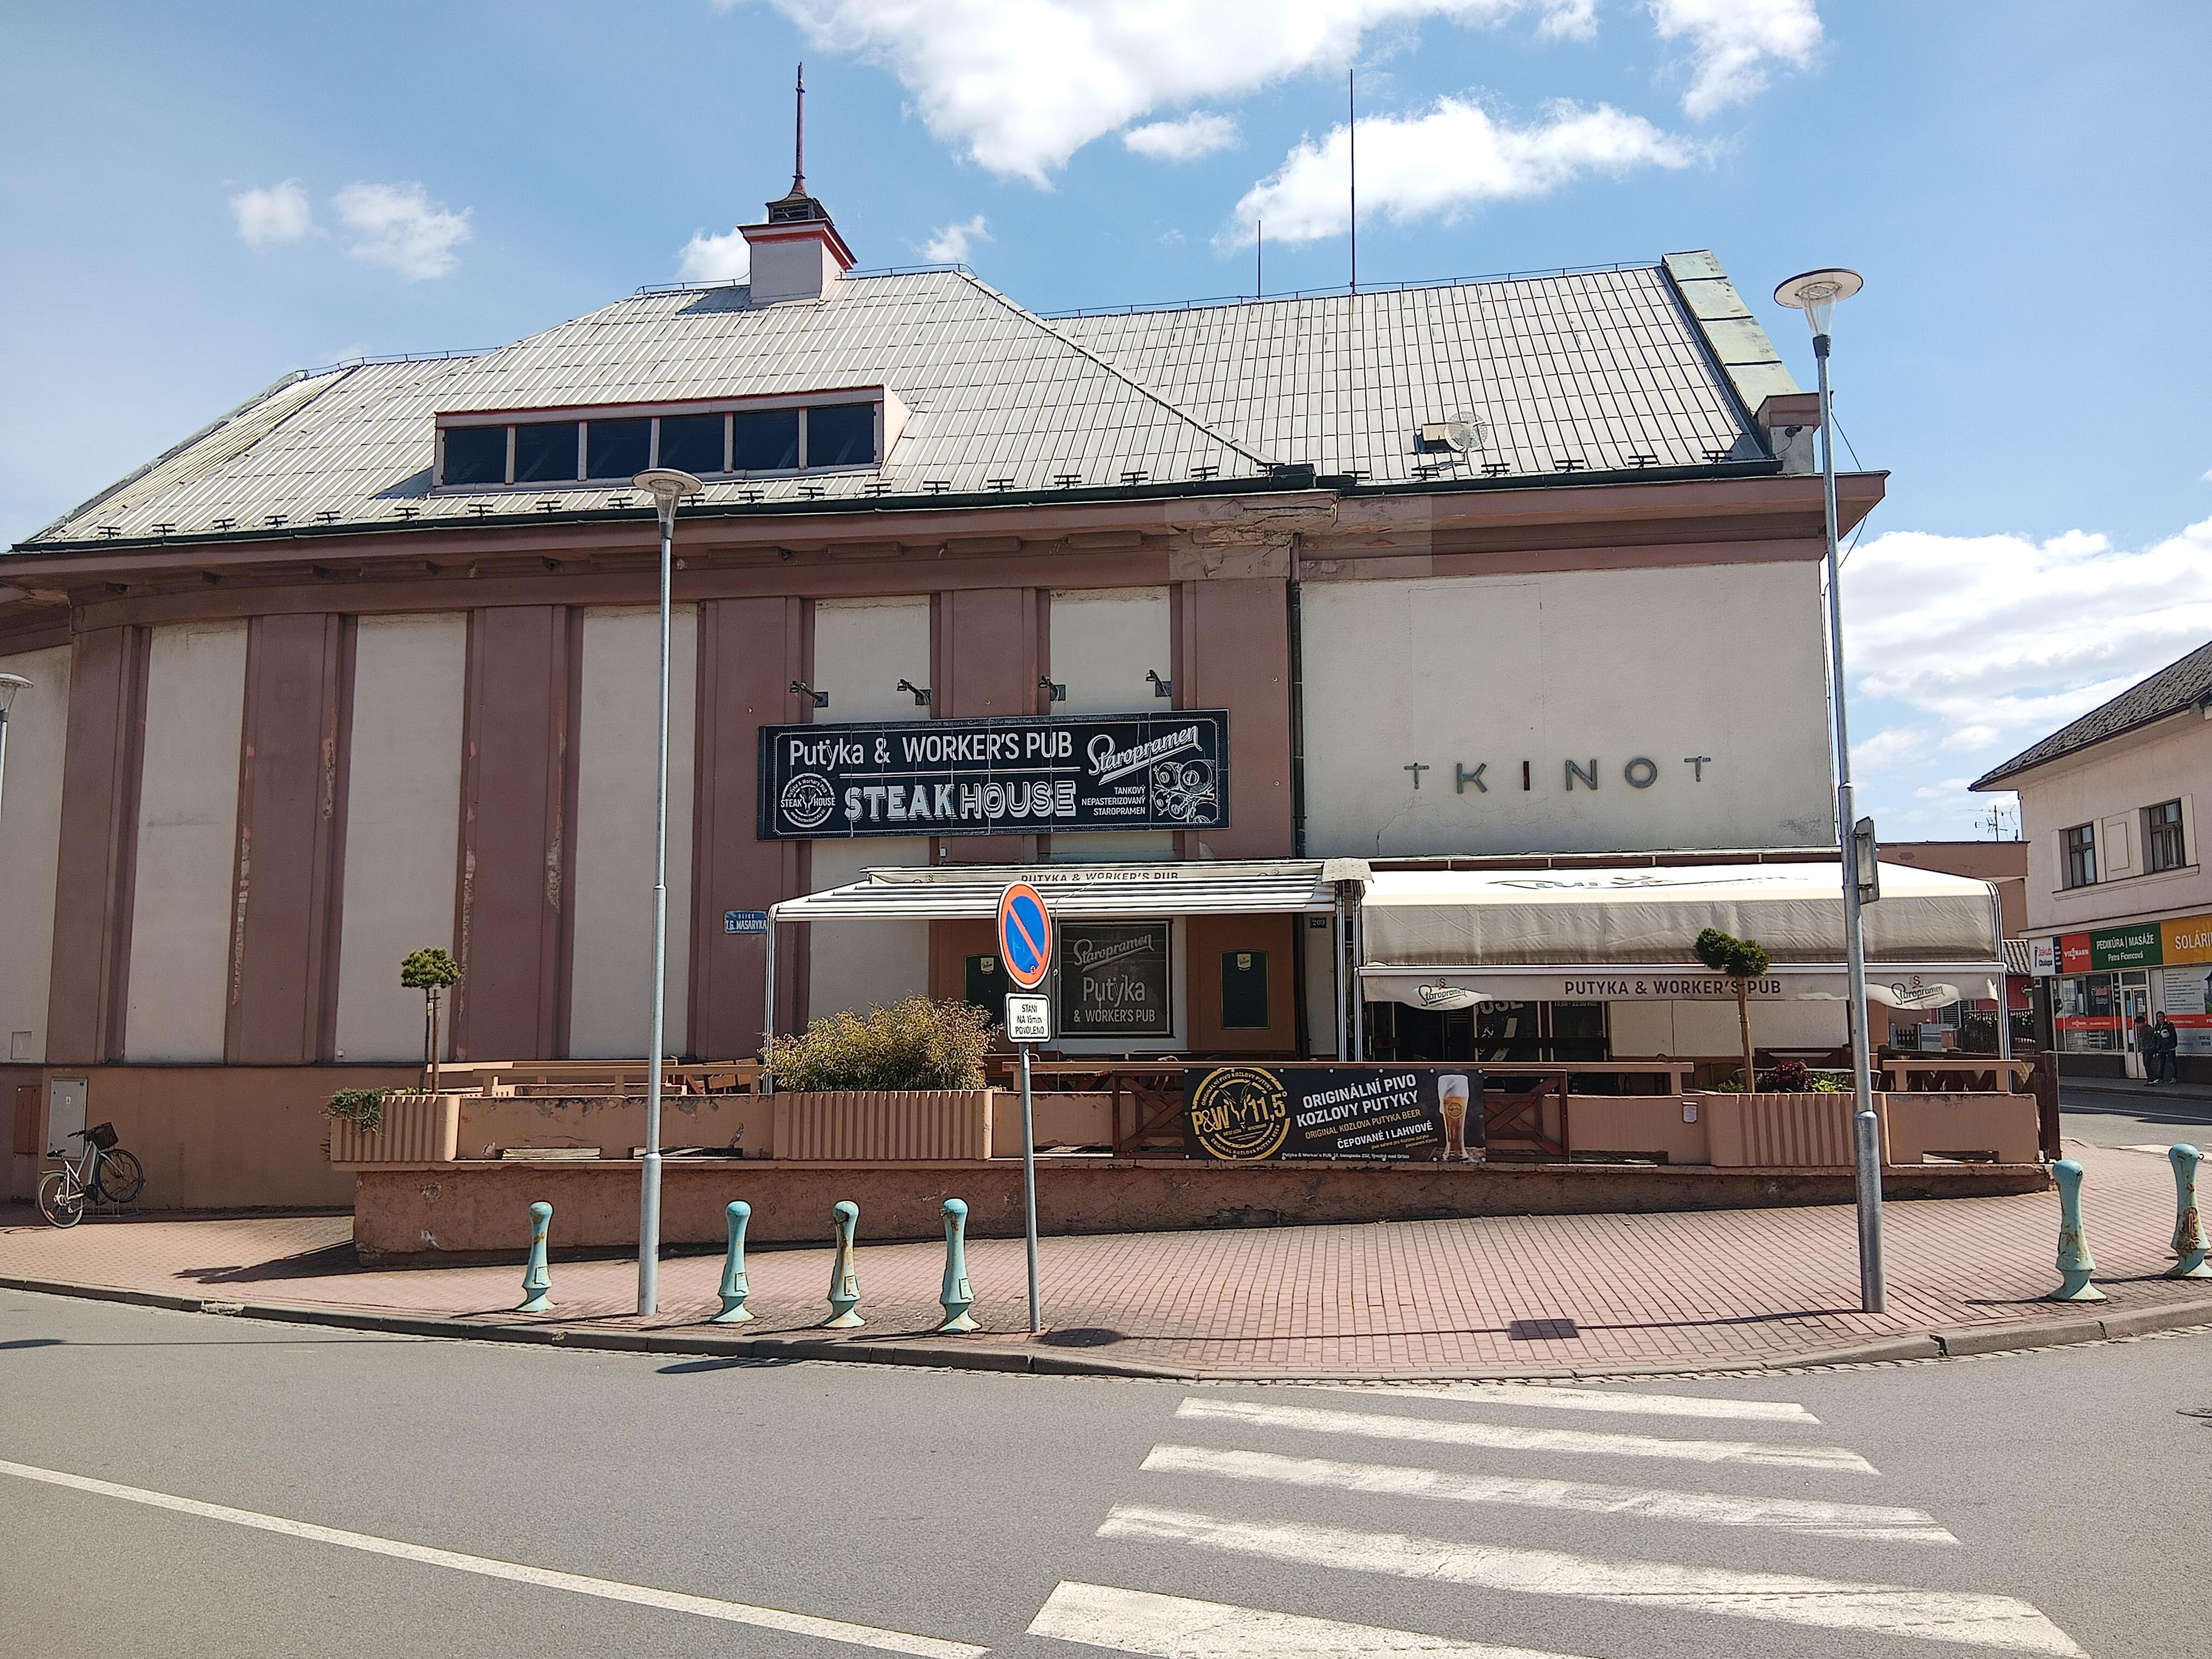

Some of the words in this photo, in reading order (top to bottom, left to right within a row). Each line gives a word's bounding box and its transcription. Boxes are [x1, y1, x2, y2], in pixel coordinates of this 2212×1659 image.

[874, 737, 891, 764] &
[902, 733, 1019, 763] WORKER'S
[1026, 731, 1072, 758] PUB
[1087, 725, 1203, 776] Staropramen
[1114, 784, 1146, 795] TANKOVÝ
[780, 798, 802, 807] STEAK
[813, 797, 836, 807] HOUSE
[1082, 795, 1146, 806] NEPASTERIZOVANÝ
[1093, 806, 1145, 816] STAROPRAMEN
[736, 920, 767, 930] MASARYKA
[2096, 937, 2124, 950] PEDIKÚRA
[2128, 932, 2154, 946] MASÁŽE
[2175, 929, 2212, 950] SOLÁRI
[1073, 934, 1155, 966] Staropramen
[1564, 980, 1629, 995] PUTYKA
[1635, 981, 1648, 994] &
[1653, 980, 1739, 994] WORKER'S
[1747, 980, 1781, 994] PUB
[1891, 983, 1945, 1005] Staropramen
[1021, 1002, 1037, 1013] STÁNÍ
[1074, 1009, 1081, 1022] &
[1085, 1009, 1134, 1022] WORKER'S
[1136, 1009, 1156, 1022] PUB
[1017, 1015, 1025, 1024] NA
[1015, 1026, 1044, 1035] POVOLENO
[1303, 1077, 1381, 1108] ORIGINÁLNÍ
[1384, 1074, 1416, 1092] PIVO
[1296, 1103, 1358, 1128] KOZLOVY
[1362, 1090, 1418, 1114] PUTYKY
[1305, 1126, 1338, 1139] ORIGINAL
[1339, 1120, 1370, 1133] KOZLOVA
[1371, 1114, 1401, 1126] PUTYKA
[1402, 1108, 1422, 1119] BEER
[1337, 1130, 1384, 1149] ČEPOVANÉ
[1386, 1131, 1390, 1139] I
[1391, 1119, 1433, 1138] LAHVOVÉ
